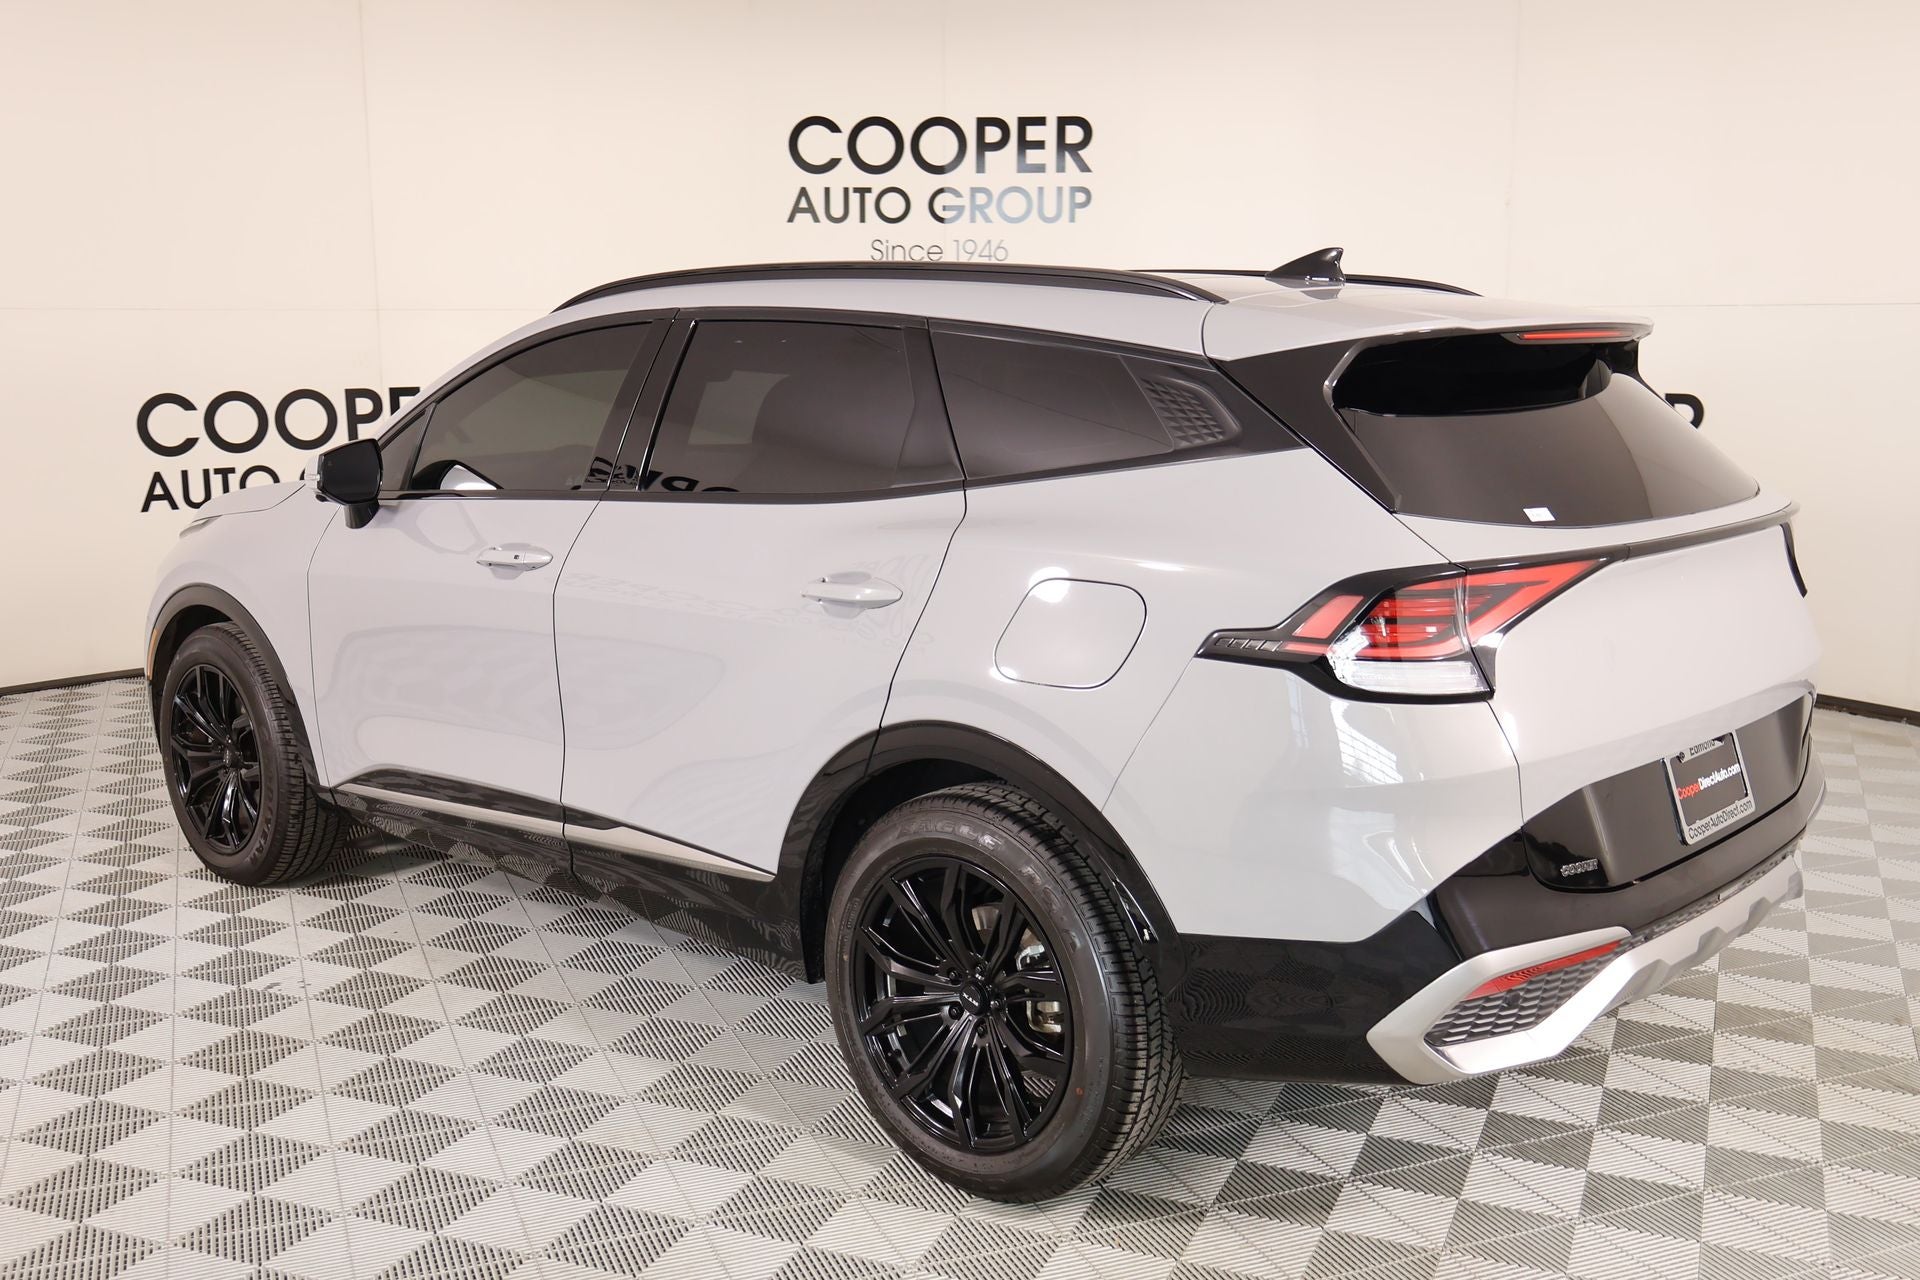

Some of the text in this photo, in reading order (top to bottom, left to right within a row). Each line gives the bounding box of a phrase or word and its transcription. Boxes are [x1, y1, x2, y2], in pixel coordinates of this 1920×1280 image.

[788, 115, 1093, 175] COOPER
[787, 186, 1093, 224] AUTO GROUP
[870, 239, 1009, 263] Since 1946
[137, 387, 421, 457] COOP
[1676, 763, 1741, 800] CooperDirectAuto.com
[1688, 799, 1754, 840] CooperAutoDirect.com
